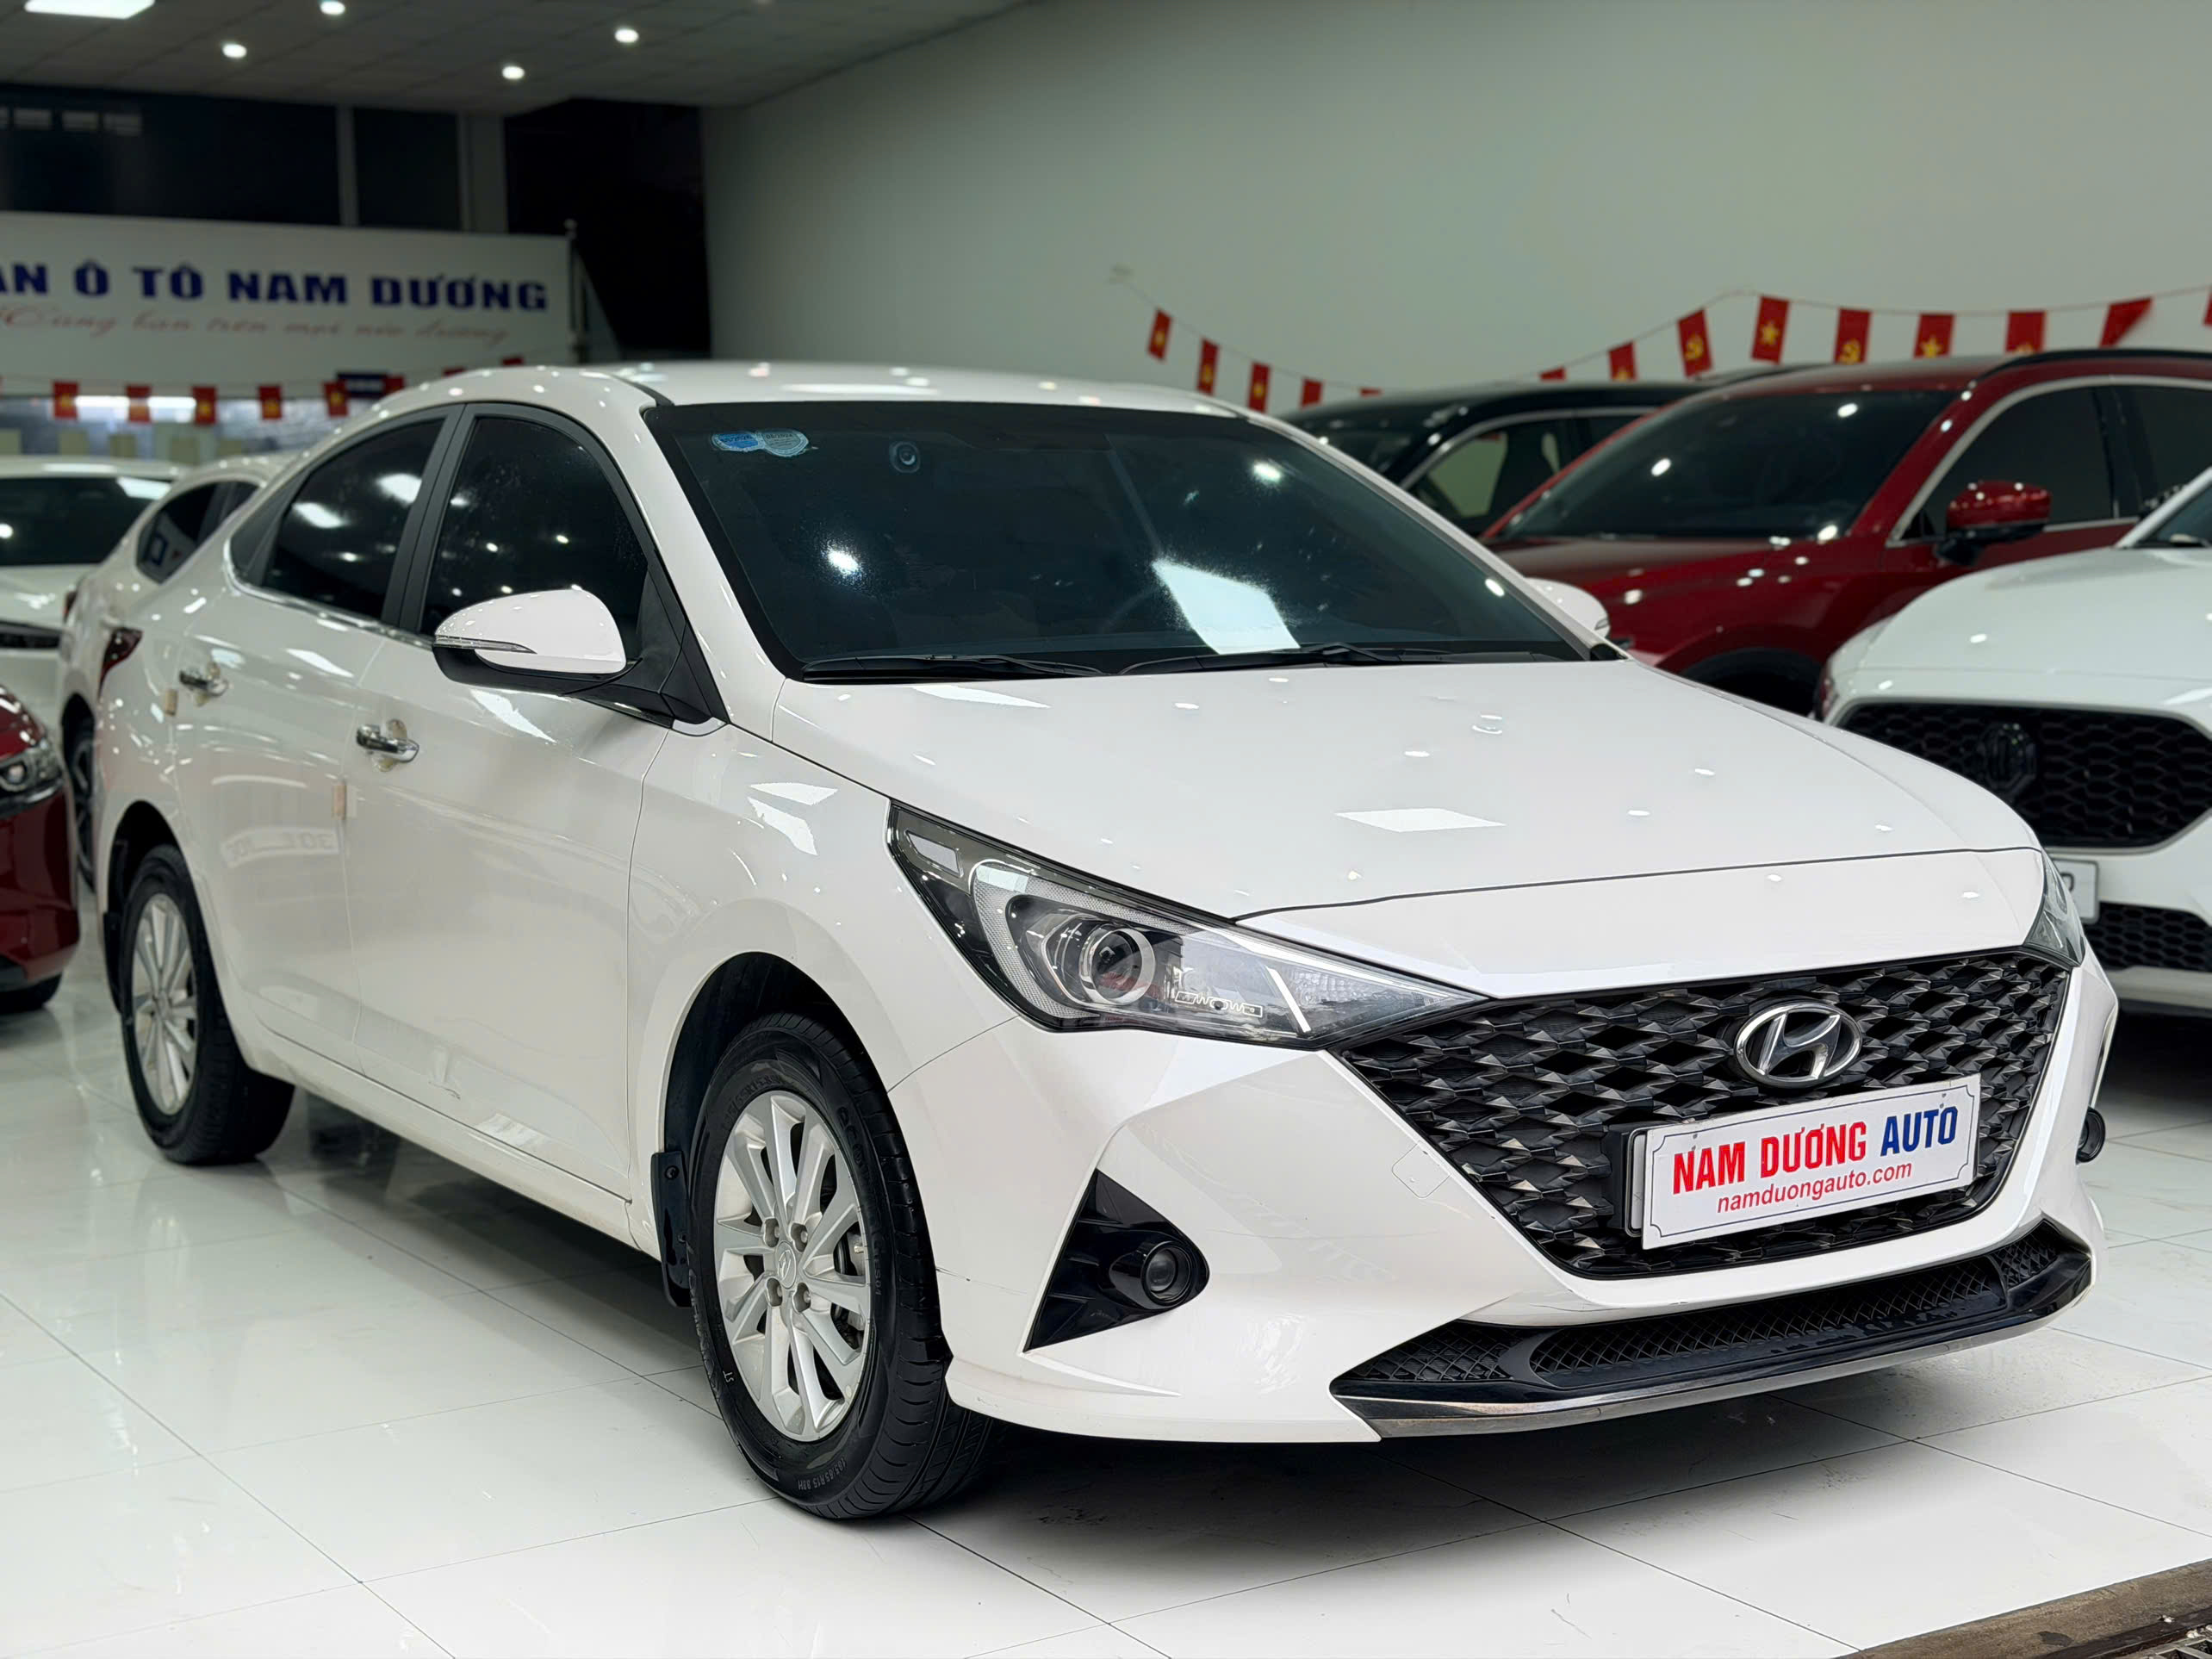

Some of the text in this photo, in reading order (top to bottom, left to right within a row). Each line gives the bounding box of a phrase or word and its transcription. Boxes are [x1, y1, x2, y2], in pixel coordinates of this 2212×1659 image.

[74, 258, 110, 296] Ô
[132, 260, 204, 300] TÔ
[227, 271, 347, 305] NAM
[370, 274, 549, 311] DƯƠNG
[1673, 1105, 1959, 1195] NAM DƯƠNG AUTO
[1717, 1161, 1912, 1214] namduongauto.com
